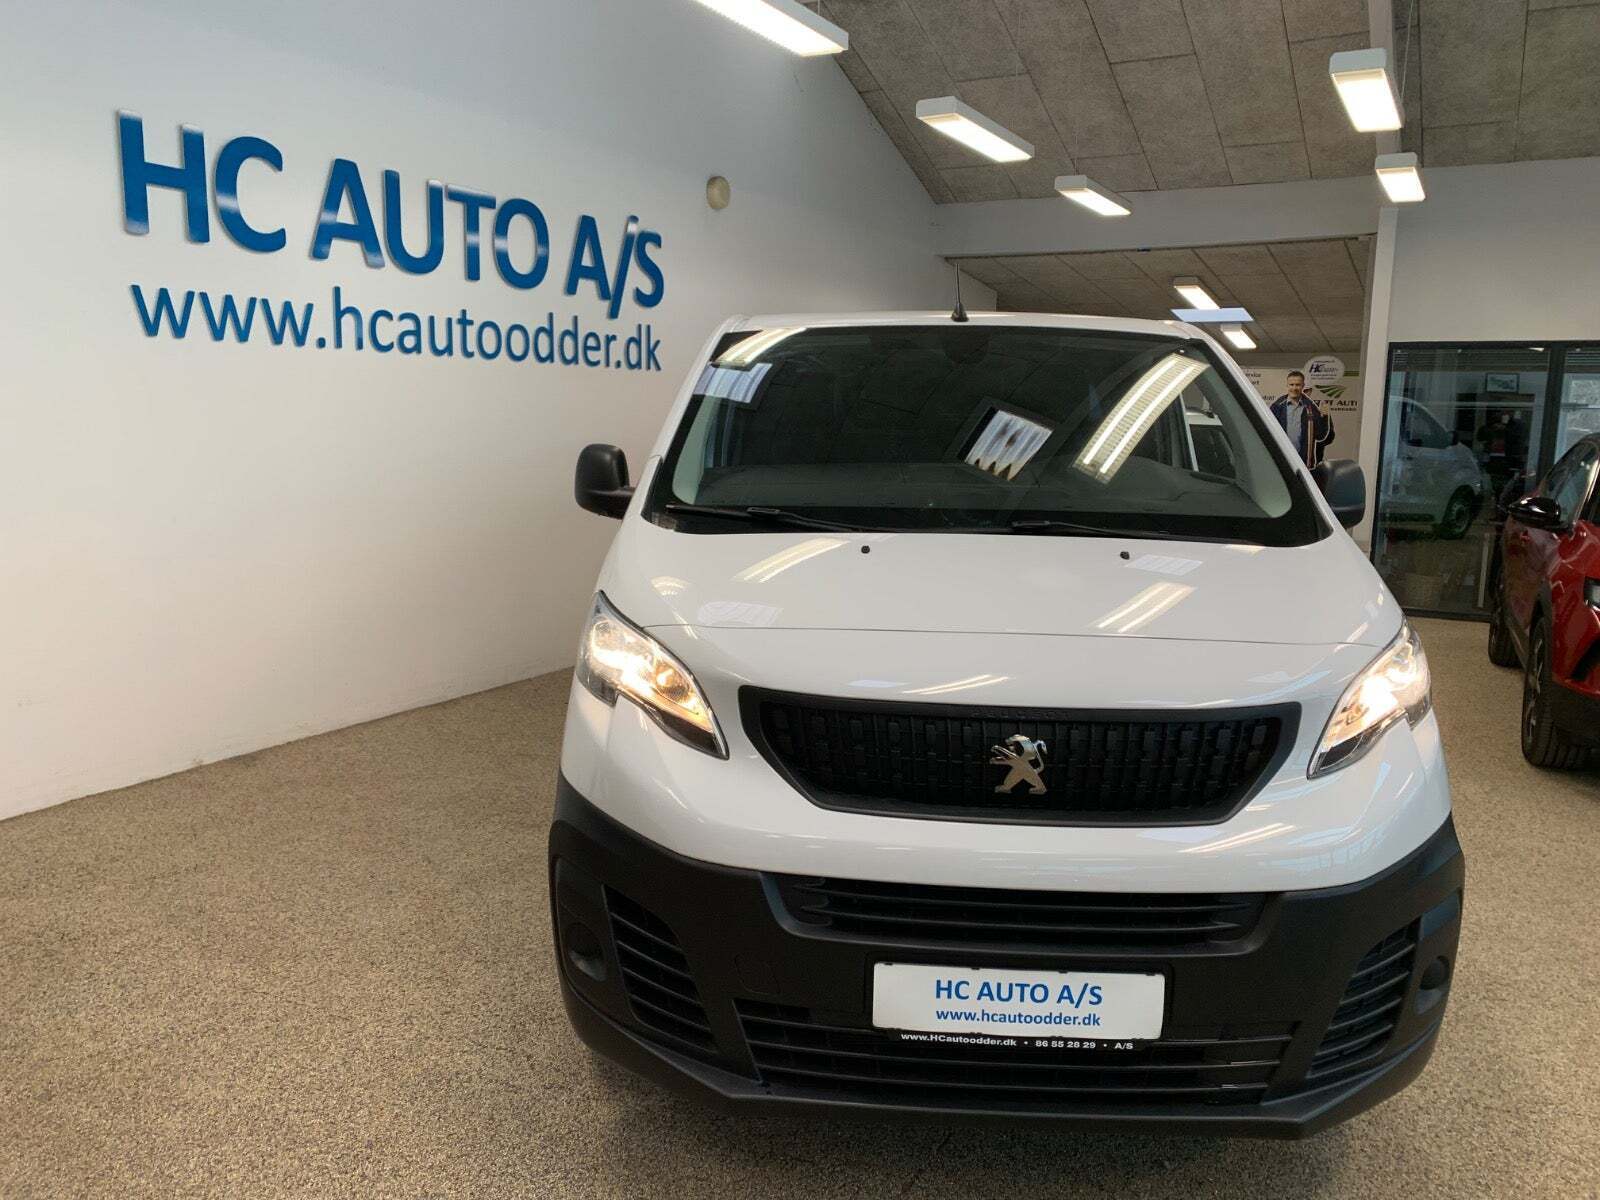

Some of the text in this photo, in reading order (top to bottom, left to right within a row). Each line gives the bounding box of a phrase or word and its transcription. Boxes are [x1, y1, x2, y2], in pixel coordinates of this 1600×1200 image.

[117, 108, 665, 320] HC AUTO A/S
[131, 283, 662, 372] www.hcautoodder.dk
[935, 980, 1103, 1008] HC AUTO A/S
[936, 1009, 1101, 1026] www.hcautoodder.dk
[901, 1032, 1017, 1047] www.HCautoodder.dk
[1035, 1040, 1048, 1048] 86
[1068, 1041, 1080, 1049] 28
[1083, 1041, 1096, 1049] 29
[1114, 1042, 1133, 1050] A/S
